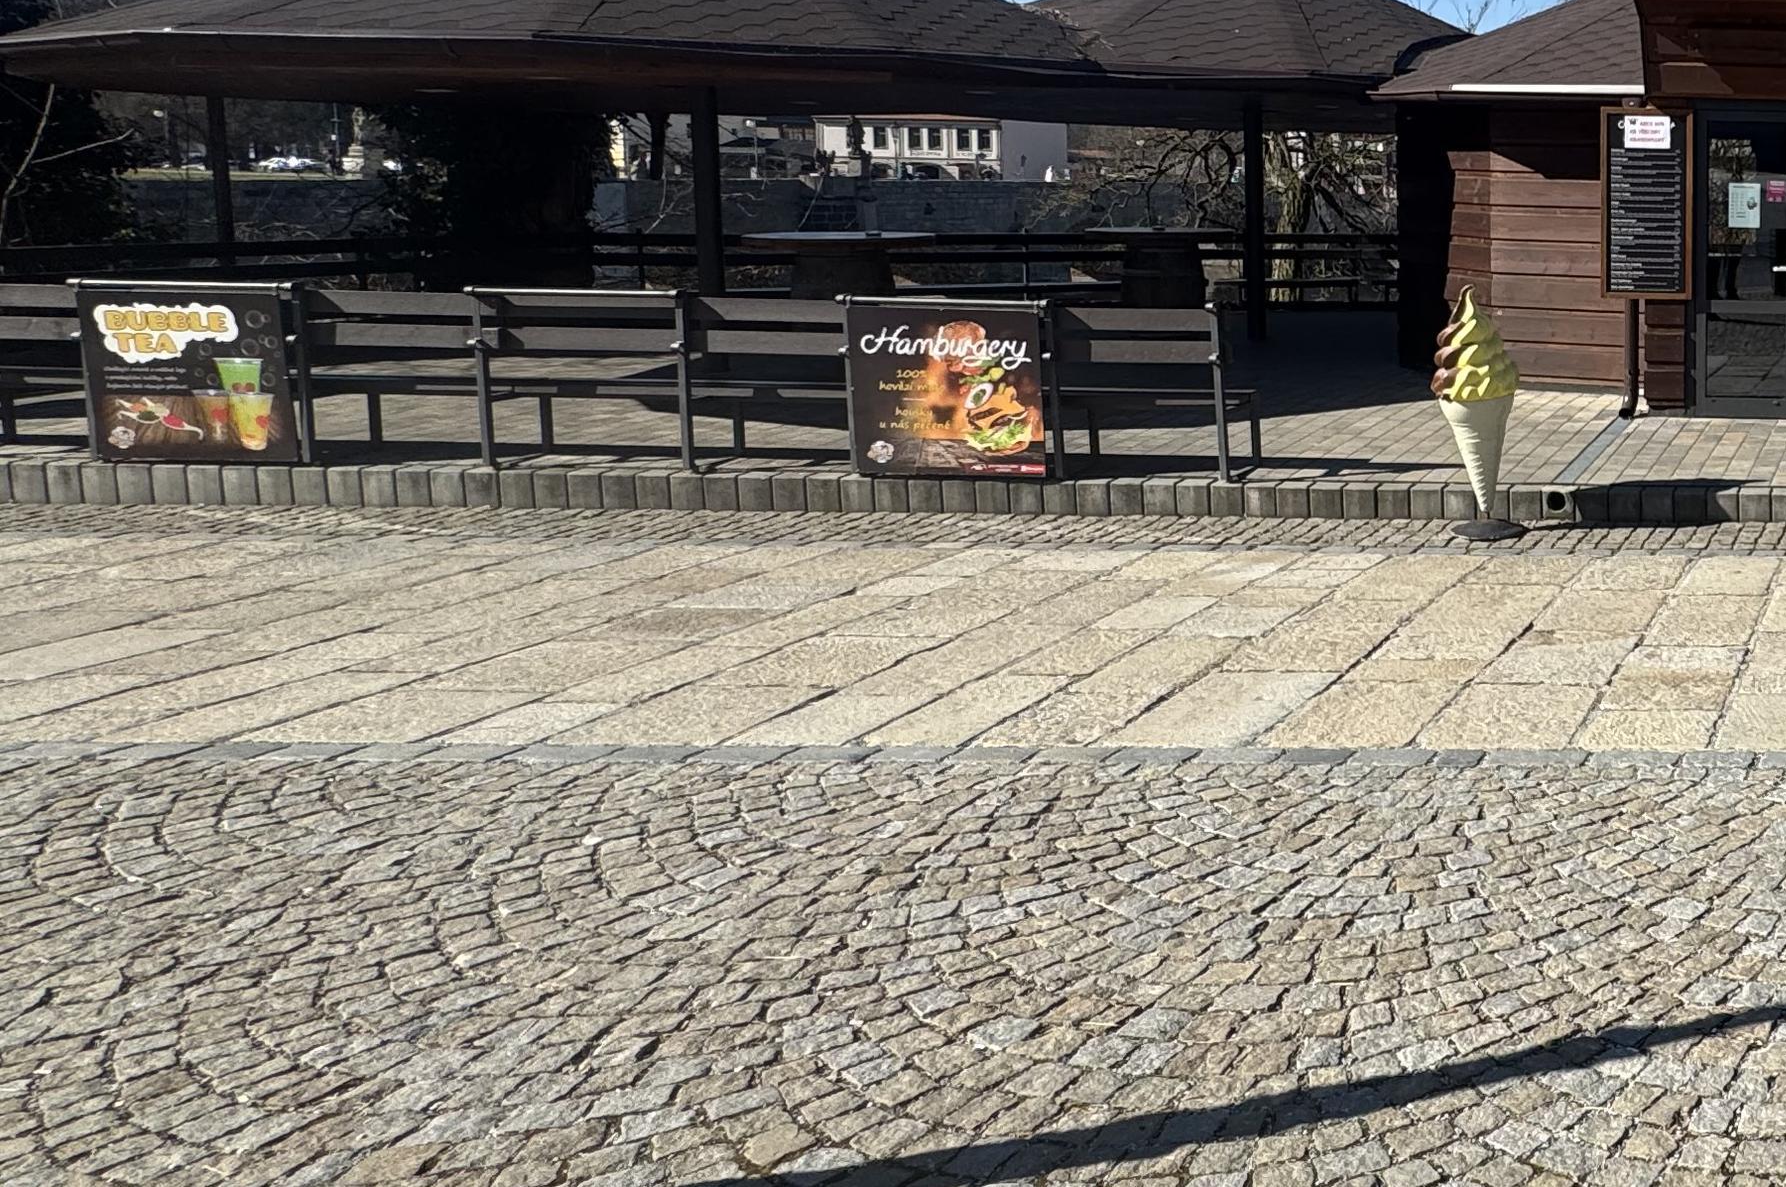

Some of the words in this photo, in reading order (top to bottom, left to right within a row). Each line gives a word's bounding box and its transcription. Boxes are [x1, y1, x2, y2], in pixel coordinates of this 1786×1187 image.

[103, 310, 229, 332] BUBBLE
[112, 332, 178, 354] TEA
[860, 325, 1032, 370] Hamburgery
[879, 421, 886, 429] u
[890, 418, 910, 429] nás
